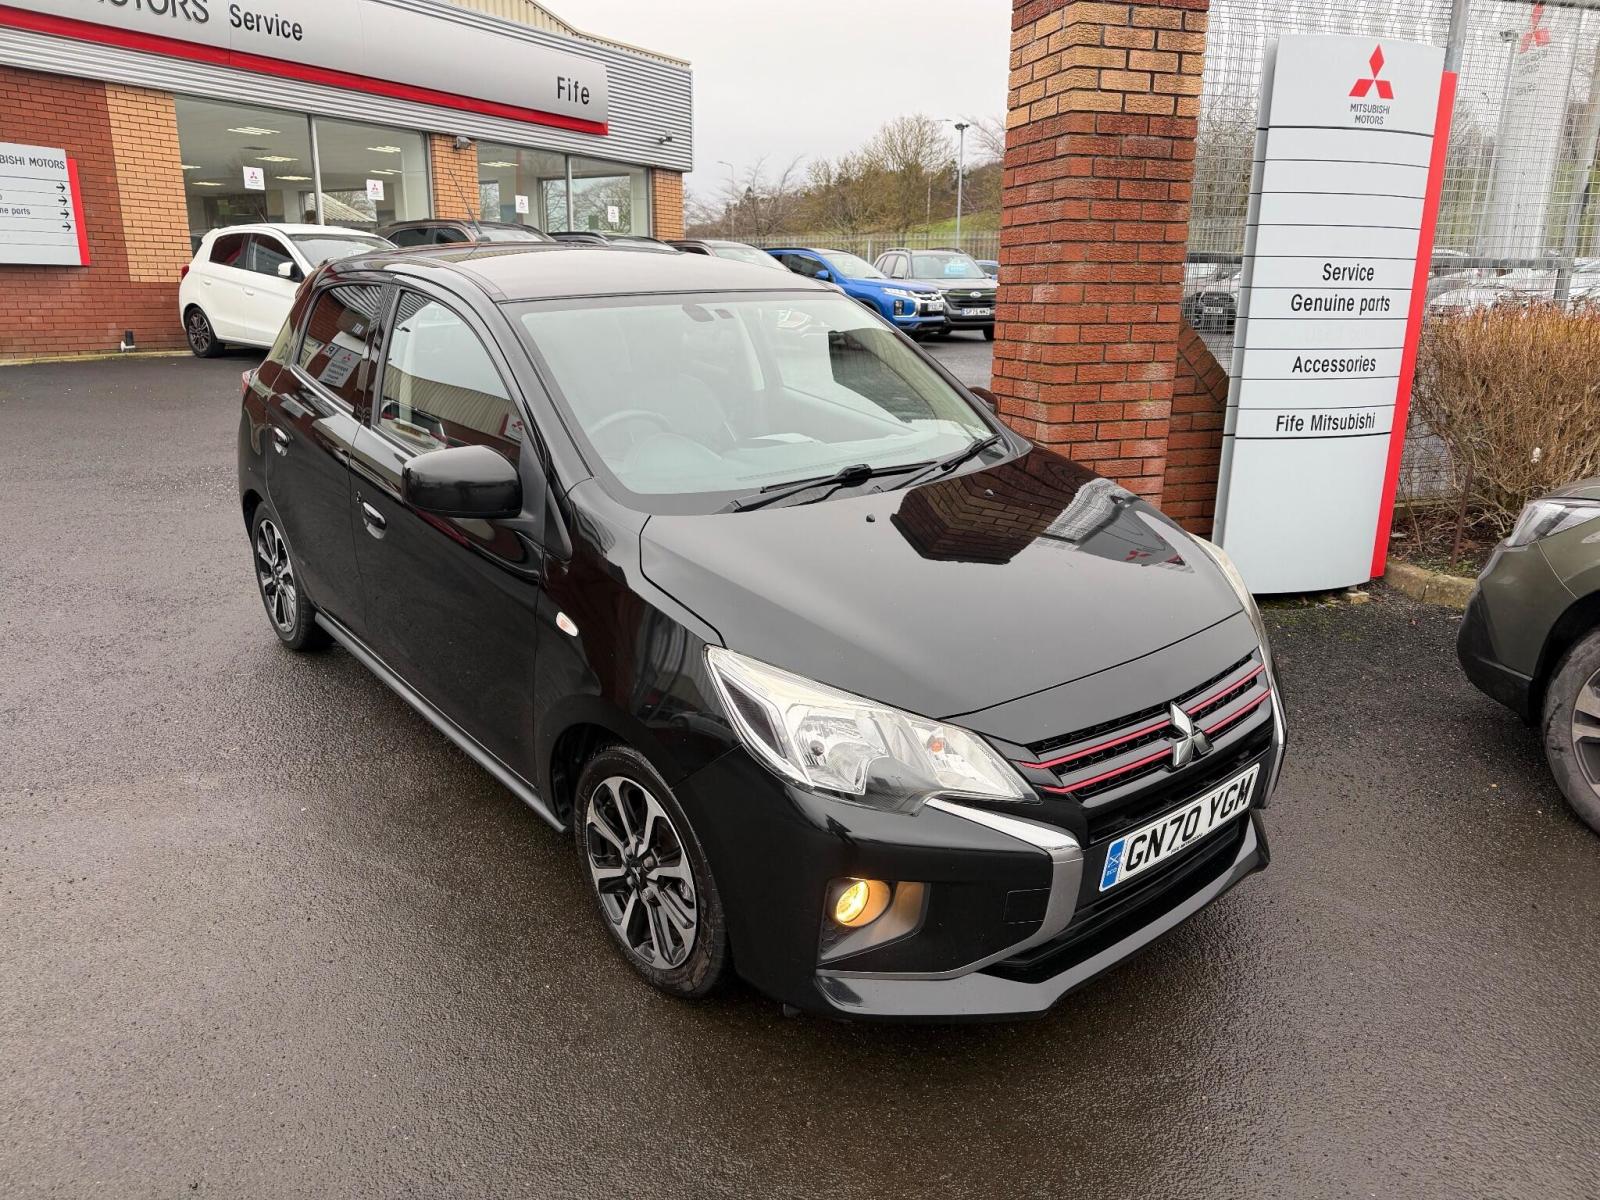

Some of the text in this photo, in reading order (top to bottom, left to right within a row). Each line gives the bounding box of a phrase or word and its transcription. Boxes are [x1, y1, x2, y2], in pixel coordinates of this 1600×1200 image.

[229, 3, 303, 41] Service
[557, 76, 590, 105] Fife
[1350, 103, 1391, 115] MITSUBISHI
[1354, 114, 1385, 125] MOTORS
[29, 157, 65, 170] MOTORS
[11, 207, 31, 216] parts
[1322, 263, 1375, 281] Service
[1291, 293, 1391, 316] Genuine parts
[1292, 355, 1376, 373] Accessories
[1276, 413, 1376, 432] Fife Mitsubishi
[1125, 773, 1254, 871] GN70 YGM
